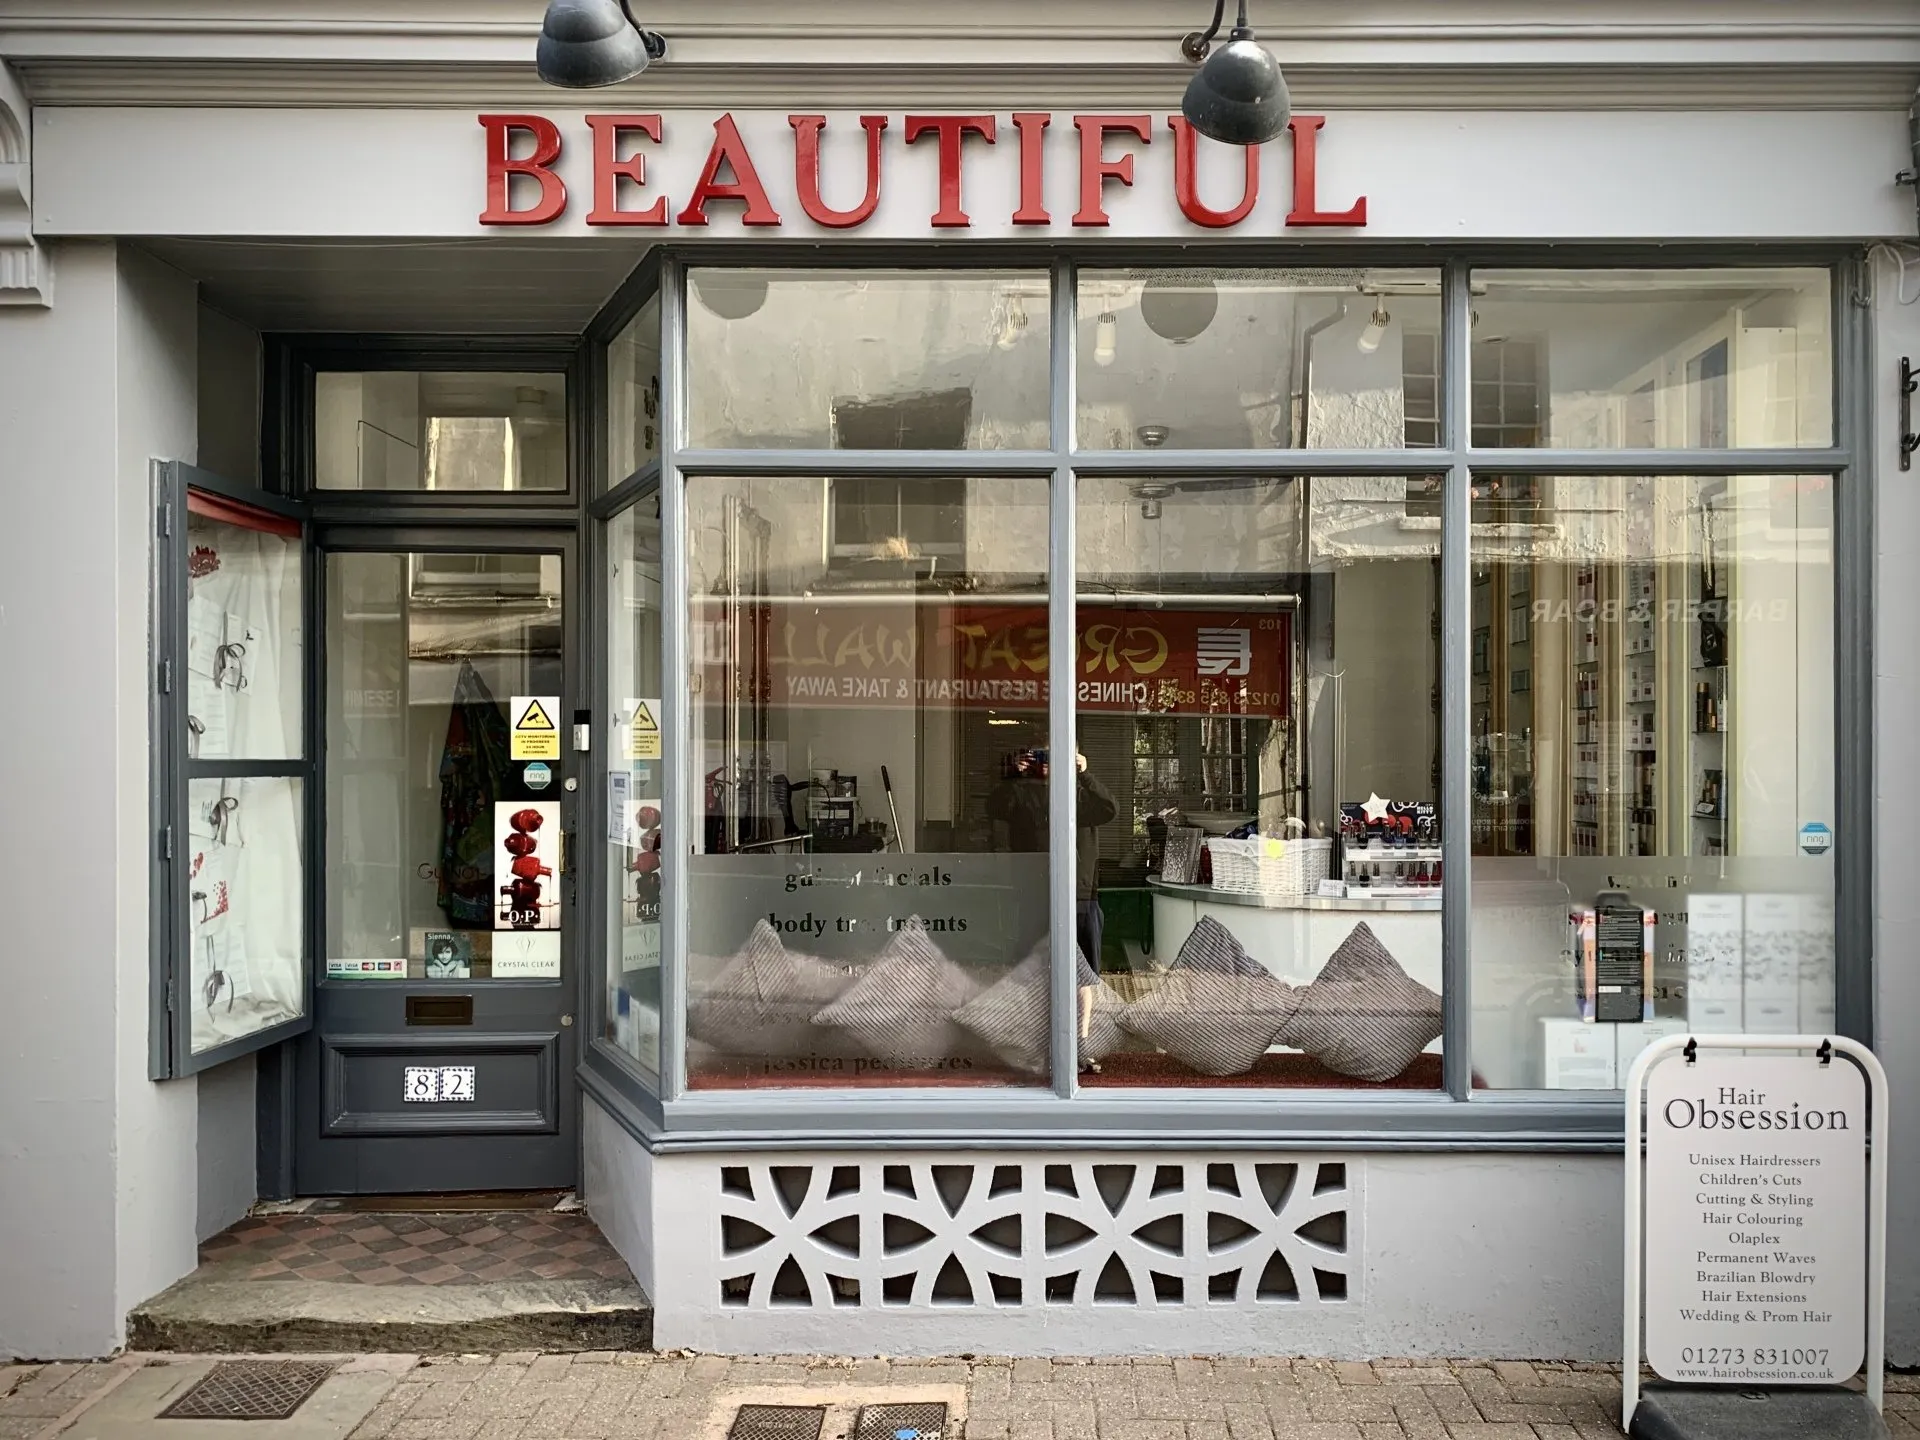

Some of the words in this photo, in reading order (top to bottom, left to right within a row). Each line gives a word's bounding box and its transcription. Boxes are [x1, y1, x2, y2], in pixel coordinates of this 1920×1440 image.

[477, 111, 1368, 229] BEAUTIFUL
[1806, 835, 1824, 845] ring
[769, 913, 827, 938] body
[427, 932, 451, 941] Sienna
[497, 960, 529, 968] CRYSTAL
[531, 960, 555, 968] CLEAR
[413, 1074, 465, 1096] 82
[1718, 1087, 1766, 1105] Hair
[1663, 1098, 1850, 1130] Obsession
[1689, 1153, 1736, 1166] Unisex
[1740, 1154, 1821, 1167] Hairdressers
[1772, 1174, 1802, 1187] Cuts
[1696, 1193, 1746, 1206] Cutting
[1750, 1194, 1764, 1205] &
[1768, 1194, 1814, 1207] Styling
[1702, 1213, 1733, 1225] Hair
[1737, 1213, 1803, 1226] Colouring
[1728, 1232, 1781, 1245] Olaplex
[1697, 1251, 1768, 1263] Permanent
[1773, 1252, 1816, 1264] Waves
[1697, 1271, 1756, 1283] Brazilian
[1760, 1271, 1816, 1286] Blowdry
[1702, 1291, 1733, 1302] Hair
[1736, 1291, 1807, 1303] Extensions
[1679, 1309, 1740, 1324] Wedding
[1744, 1311, 1758, 1322] &
[1762, 1311, 1798, 1322] Prom
[1802, 1311, 1833, 1323] Hair
[1682, 1347, 1745, 1365] 01273
[1753, 1348, 1830, 1366] 831007
[1676, 1367, 1834, 1380] www.hairobsession.co.uk
